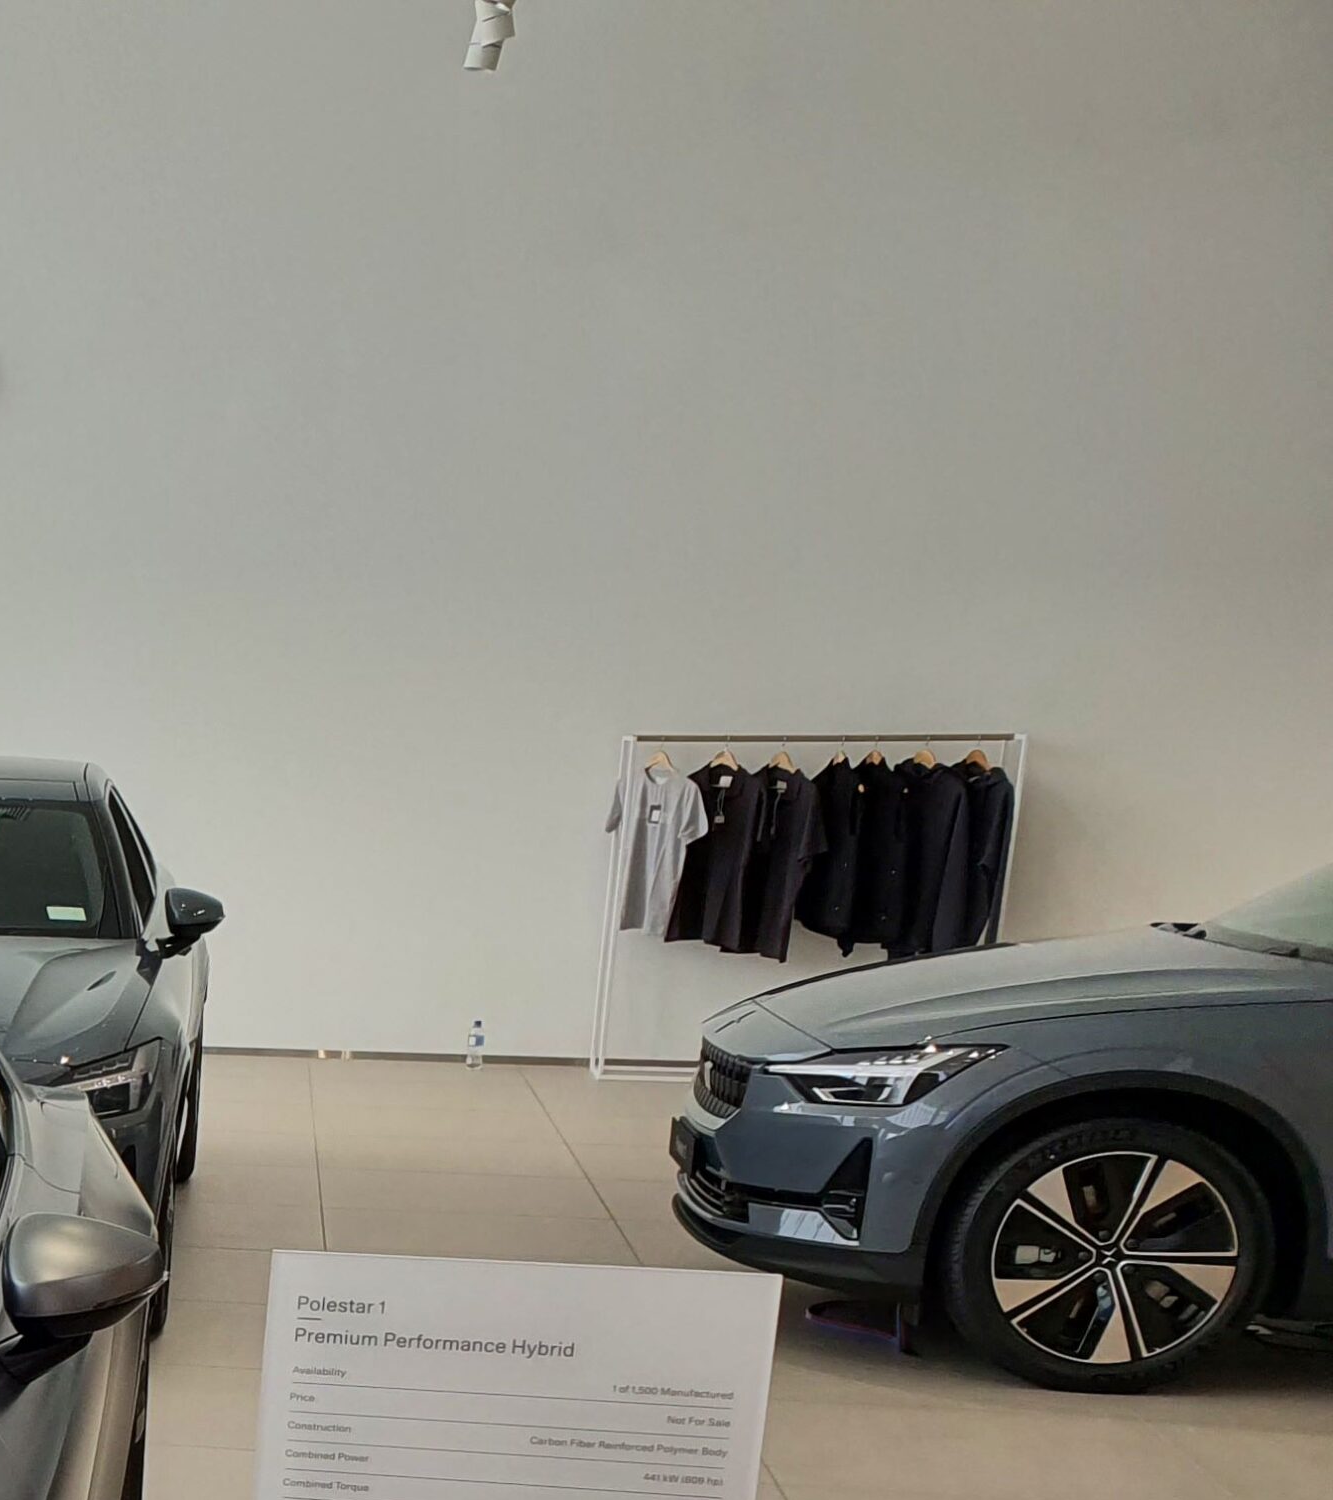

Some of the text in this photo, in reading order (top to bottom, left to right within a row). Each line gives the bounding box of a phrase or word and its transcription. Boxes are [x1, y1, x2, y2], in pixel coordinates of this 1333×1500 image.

[297, 1295, 386, 1315] Polestar 1
[294, 1327, 576, 1359] Premium Performance Hybrid
[293, 1366, 347, 1378] Availability
[290, 1391, 315, 1402] Price
[619, 1385, 630, 1394] of
[661, 1387, 734, 1400] Manufactured
[287, 1420, 352, 1433] Construction
[667, 1415, 731, 1428] Not For Sale
[530, 1436, 568, 1447] Carbon
[598, 1440, 655, 1453] Reinforced
[702, 1447, 728, 1459] Body
[285, 1449, 369, 1463] Combined Power
[282, 1478, 370, 1493] Combined Torque
